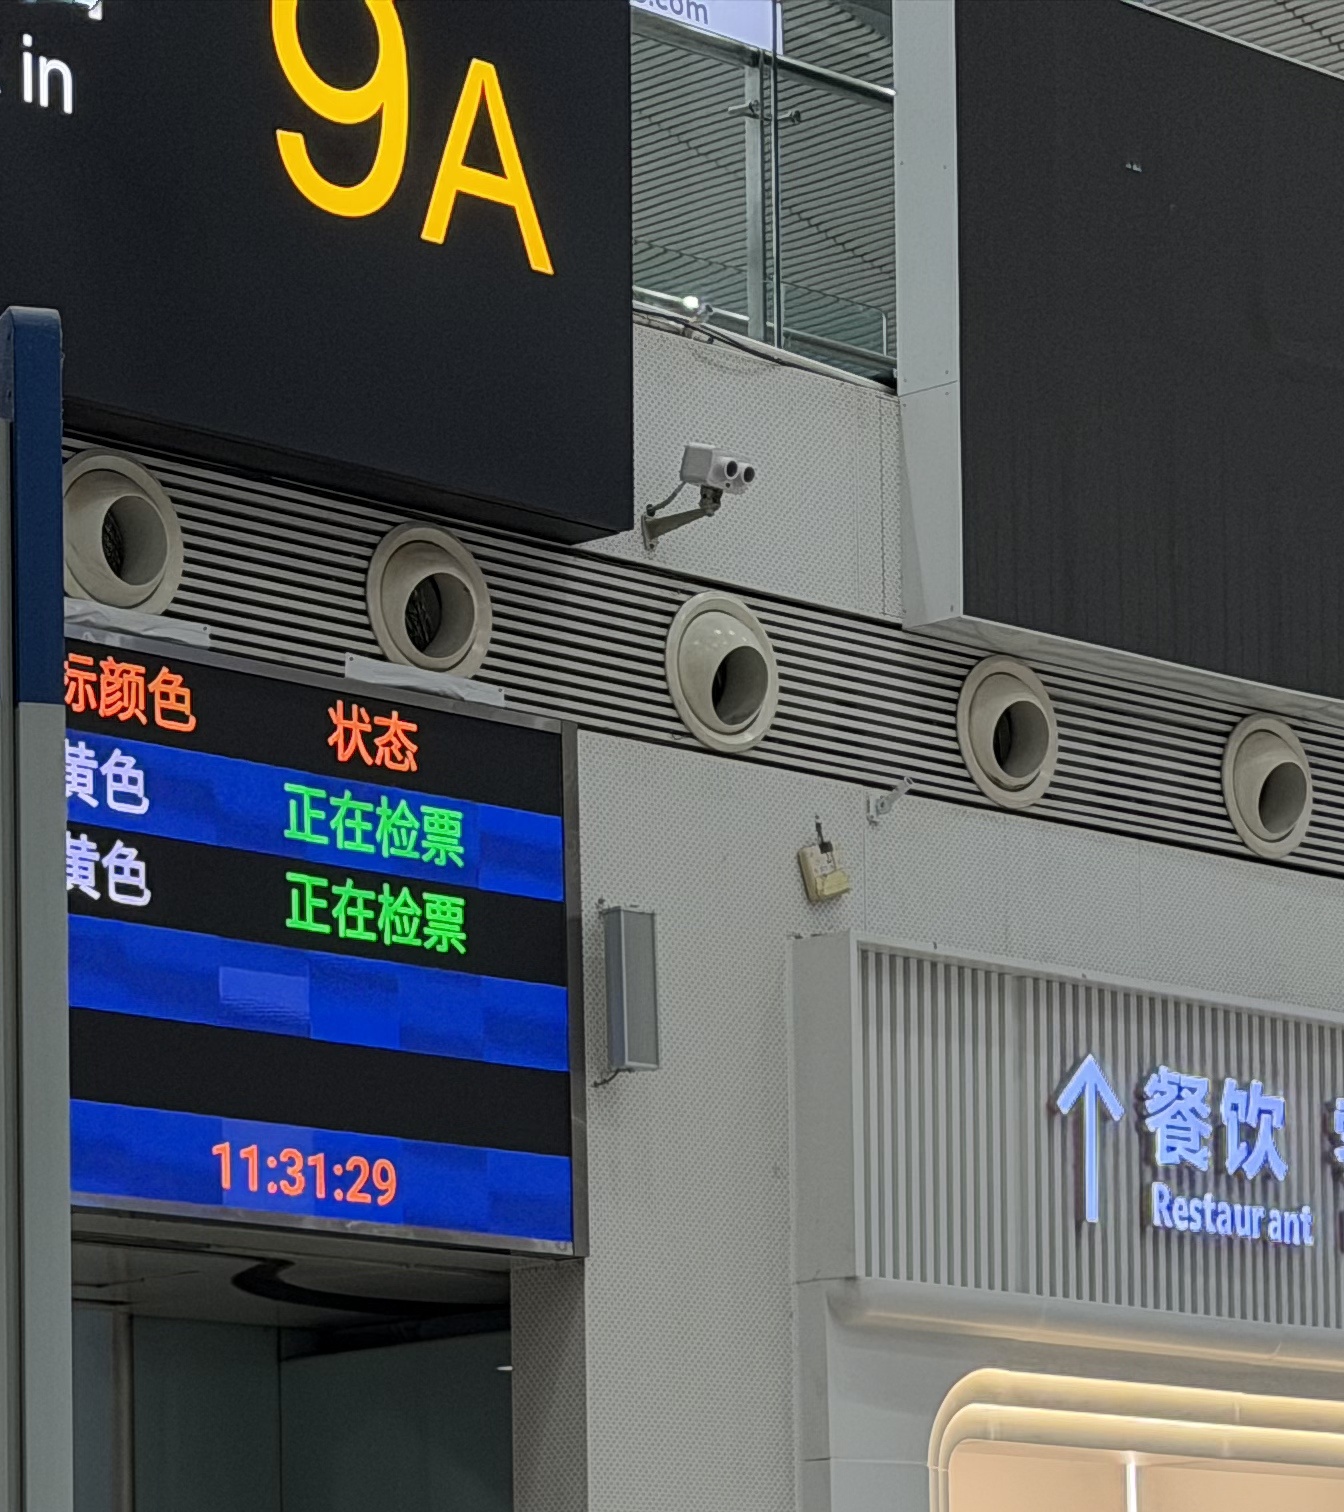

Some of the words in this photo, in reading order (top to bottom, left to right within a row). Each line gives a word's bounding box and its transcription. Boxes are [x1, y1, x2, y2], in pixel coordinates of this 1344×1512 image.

[635, 0, 708, 25] .com
[22, 33, 73, 114] in
[270, 0, 556, 276] 9A
[328, 701, 419, 771] 状态
[64, 739, 150, 816] 黄色
[283, 783, 465, 868] 正在检票
[64, 831, 152, 907] 黄色
[284, 871, 467, 954] 正在检票
[1143, 1065, 1289, 1181] 餐饮
[212, 1142, 397, 1207] 11:31:29
